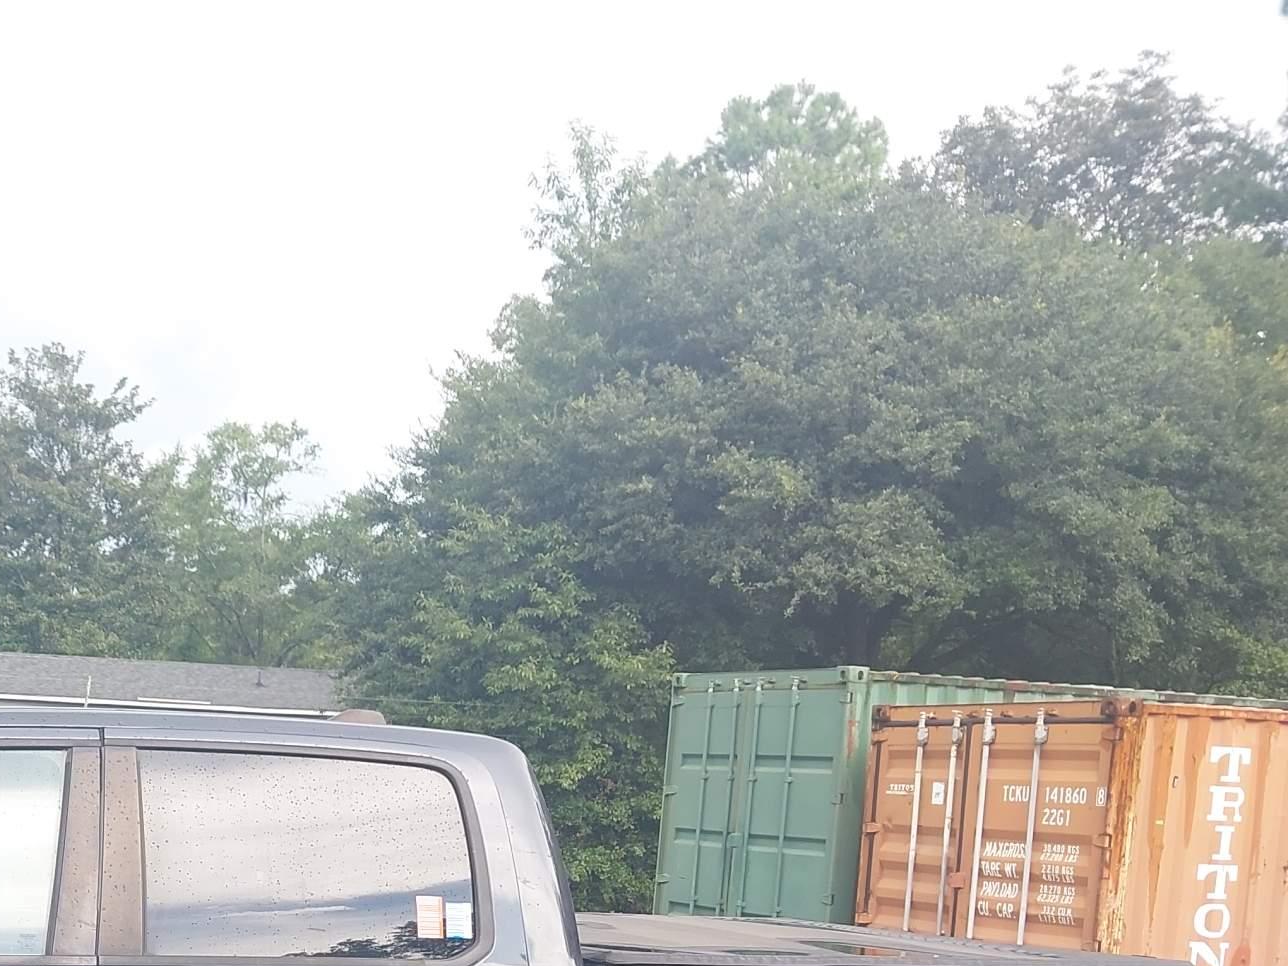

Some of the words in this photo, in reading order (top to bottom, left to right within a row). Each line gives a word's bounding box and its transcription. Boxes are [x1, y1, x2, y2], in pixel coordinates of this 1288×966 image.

[1003, 785, 1030, 802] TCKU
[1045, 786, 1087, 804] 141860
[1097, 787, 1105, 805] 8
[1042, 808, 1070, 826] 22G1
[983, 842, 1026, 858] MAXGROS
[981, 861, 1002, 877] TARE
[1004, 863, 1019, 878] WT.
[980, 881, 1018, 898] PAYLOAD
[996, 903, 1016, 918] CAP.
